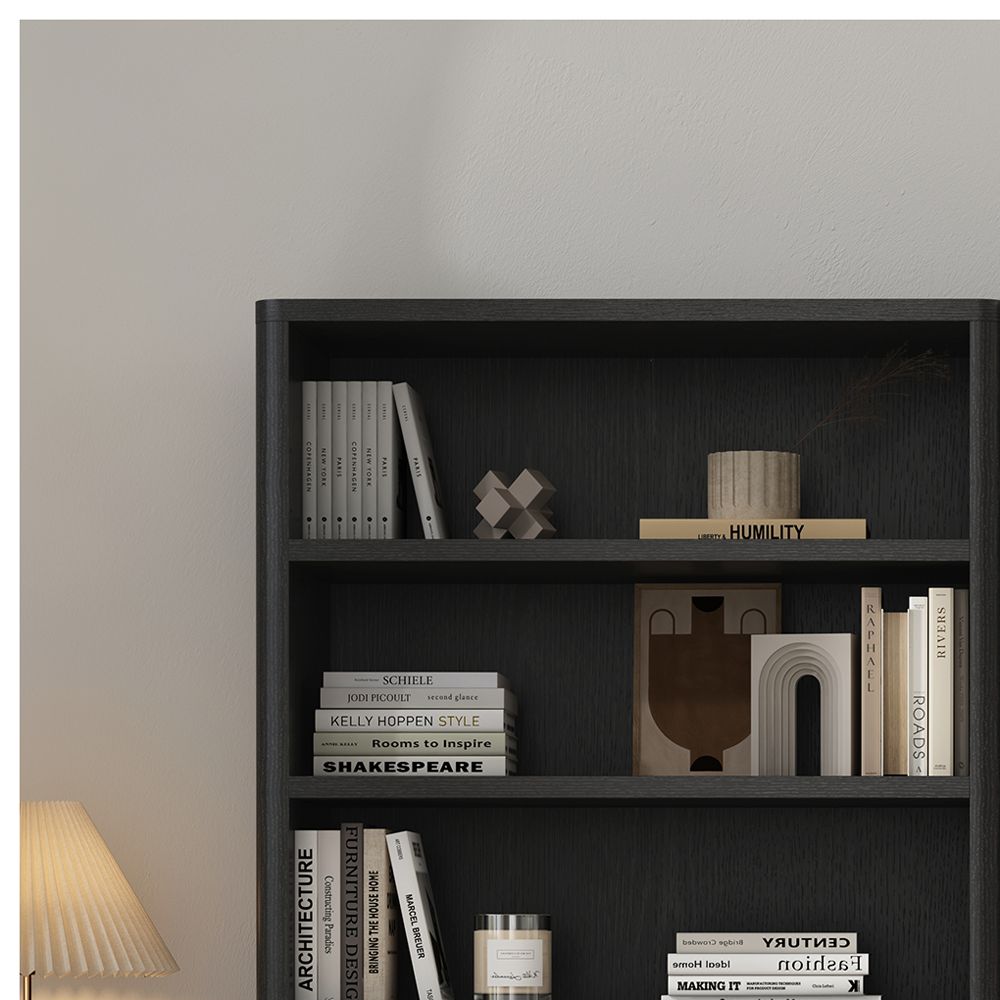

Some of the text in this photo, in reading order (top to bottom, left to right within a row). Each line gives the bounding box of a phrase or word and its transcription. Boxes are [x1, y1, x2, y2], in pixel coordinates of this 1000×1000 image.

[413, 457, 422, 478] PARIS
[730, 524, 805, 540] HUMILITY
[936, 607, 946, 658] RIVERS
[866, 604, 876, 693] RAPHAEL
[383, 676, 434, 685] SCHIELE
[347, 694, 411, 703] JODI PICOULT
[454, 694, 478, 702] glance
[331, 716, 480, 727] KELLY HOPPEN STYLE
[913, 695, 926, 760] ROADS
[372, 739, 492, 750] Rooms to Inspire
[322, 761, 483, 773] SHAKESPEARE
[346, 826, 358, 938] FURNITURE
[322, 875, 334, 922] Constructing
[298, 848, 313, 992] ARCHITECTURE
[369, 870, 379, 974] BRINGING THE HOUSE HOME
[406, 894, 426, 960] MARCEL BREUER
[677, 981, 741, 991] MAKING IT
